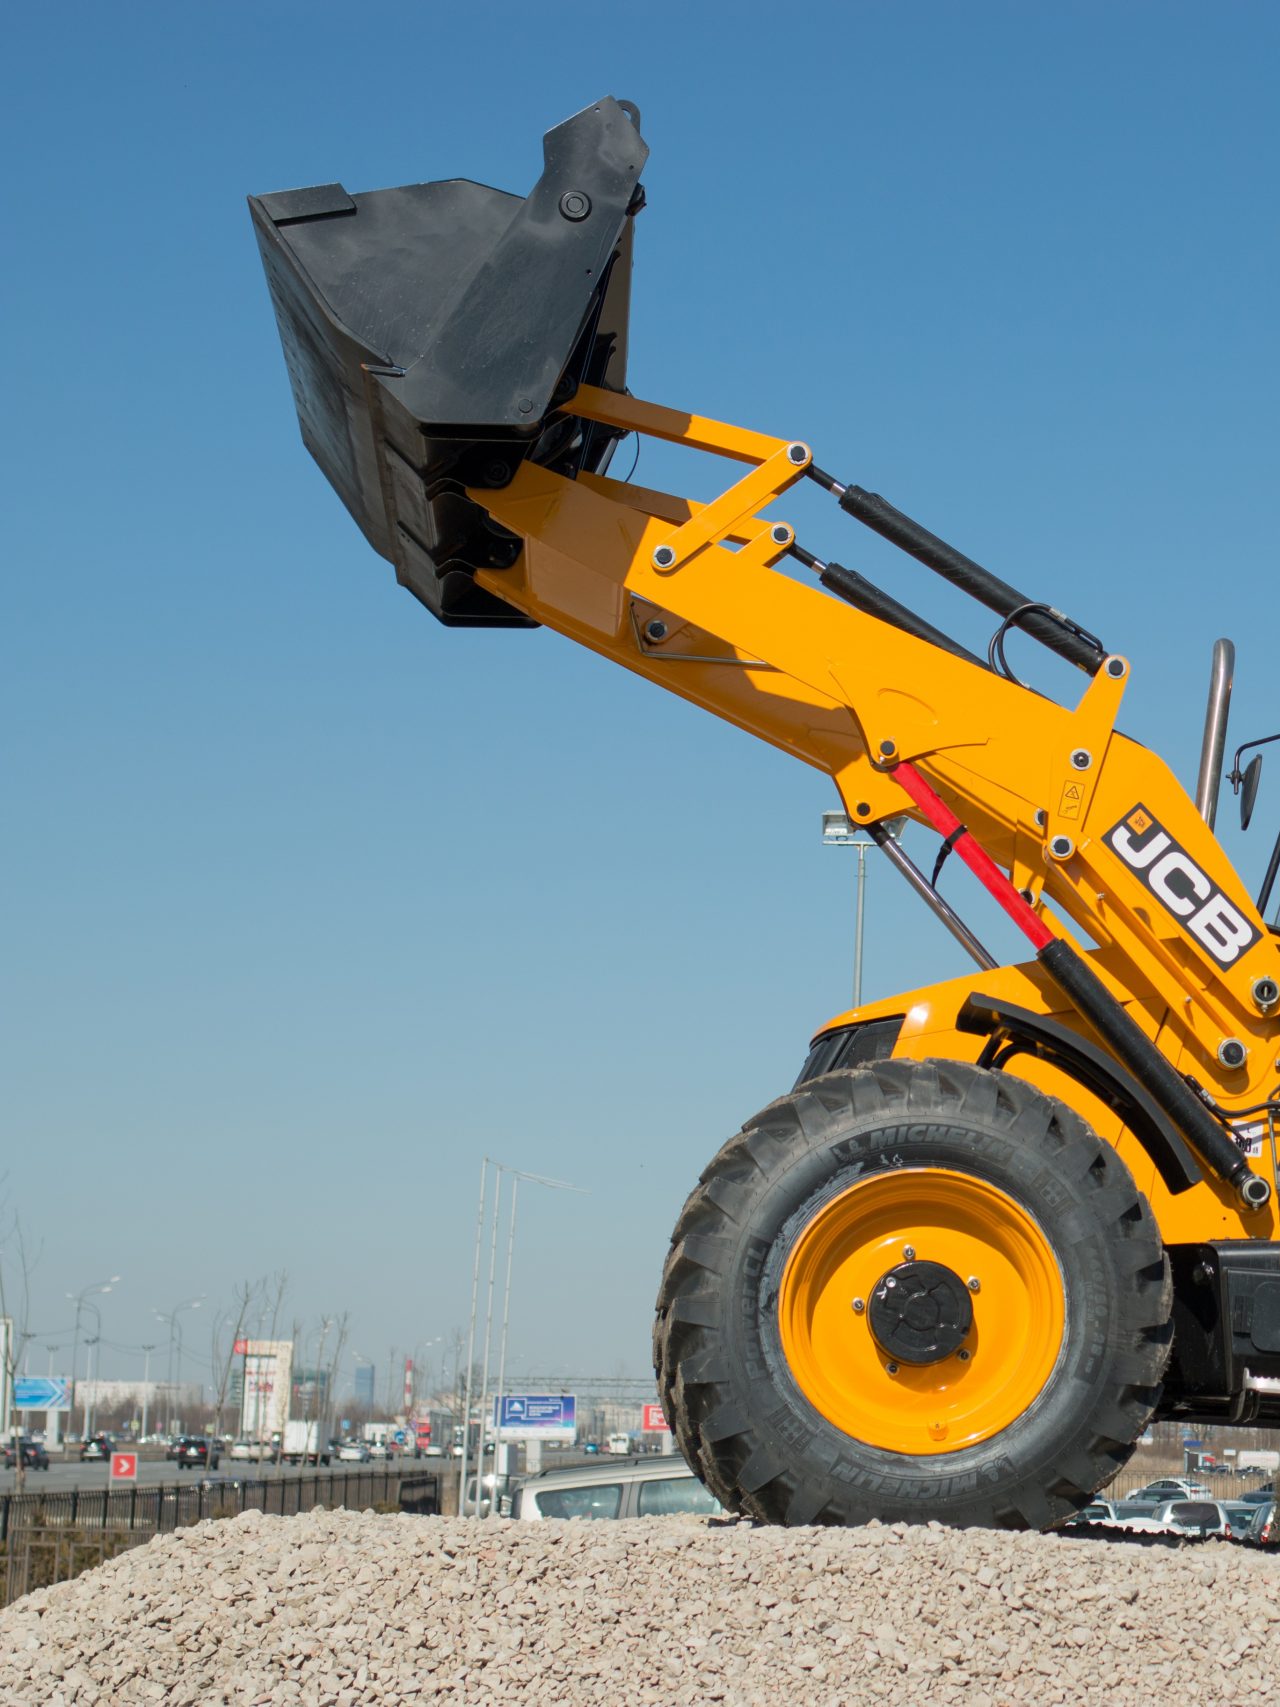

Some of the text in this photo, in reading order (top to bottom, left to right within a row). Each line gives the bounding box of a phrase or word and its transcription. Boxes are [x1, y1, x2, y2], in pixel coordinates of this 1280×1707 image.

[1111, 825, 1254, 962] JCB
[870, 1125, 1014, 1158] MICHELIN
[831, 1461, 978, 1499] MICHELIN
